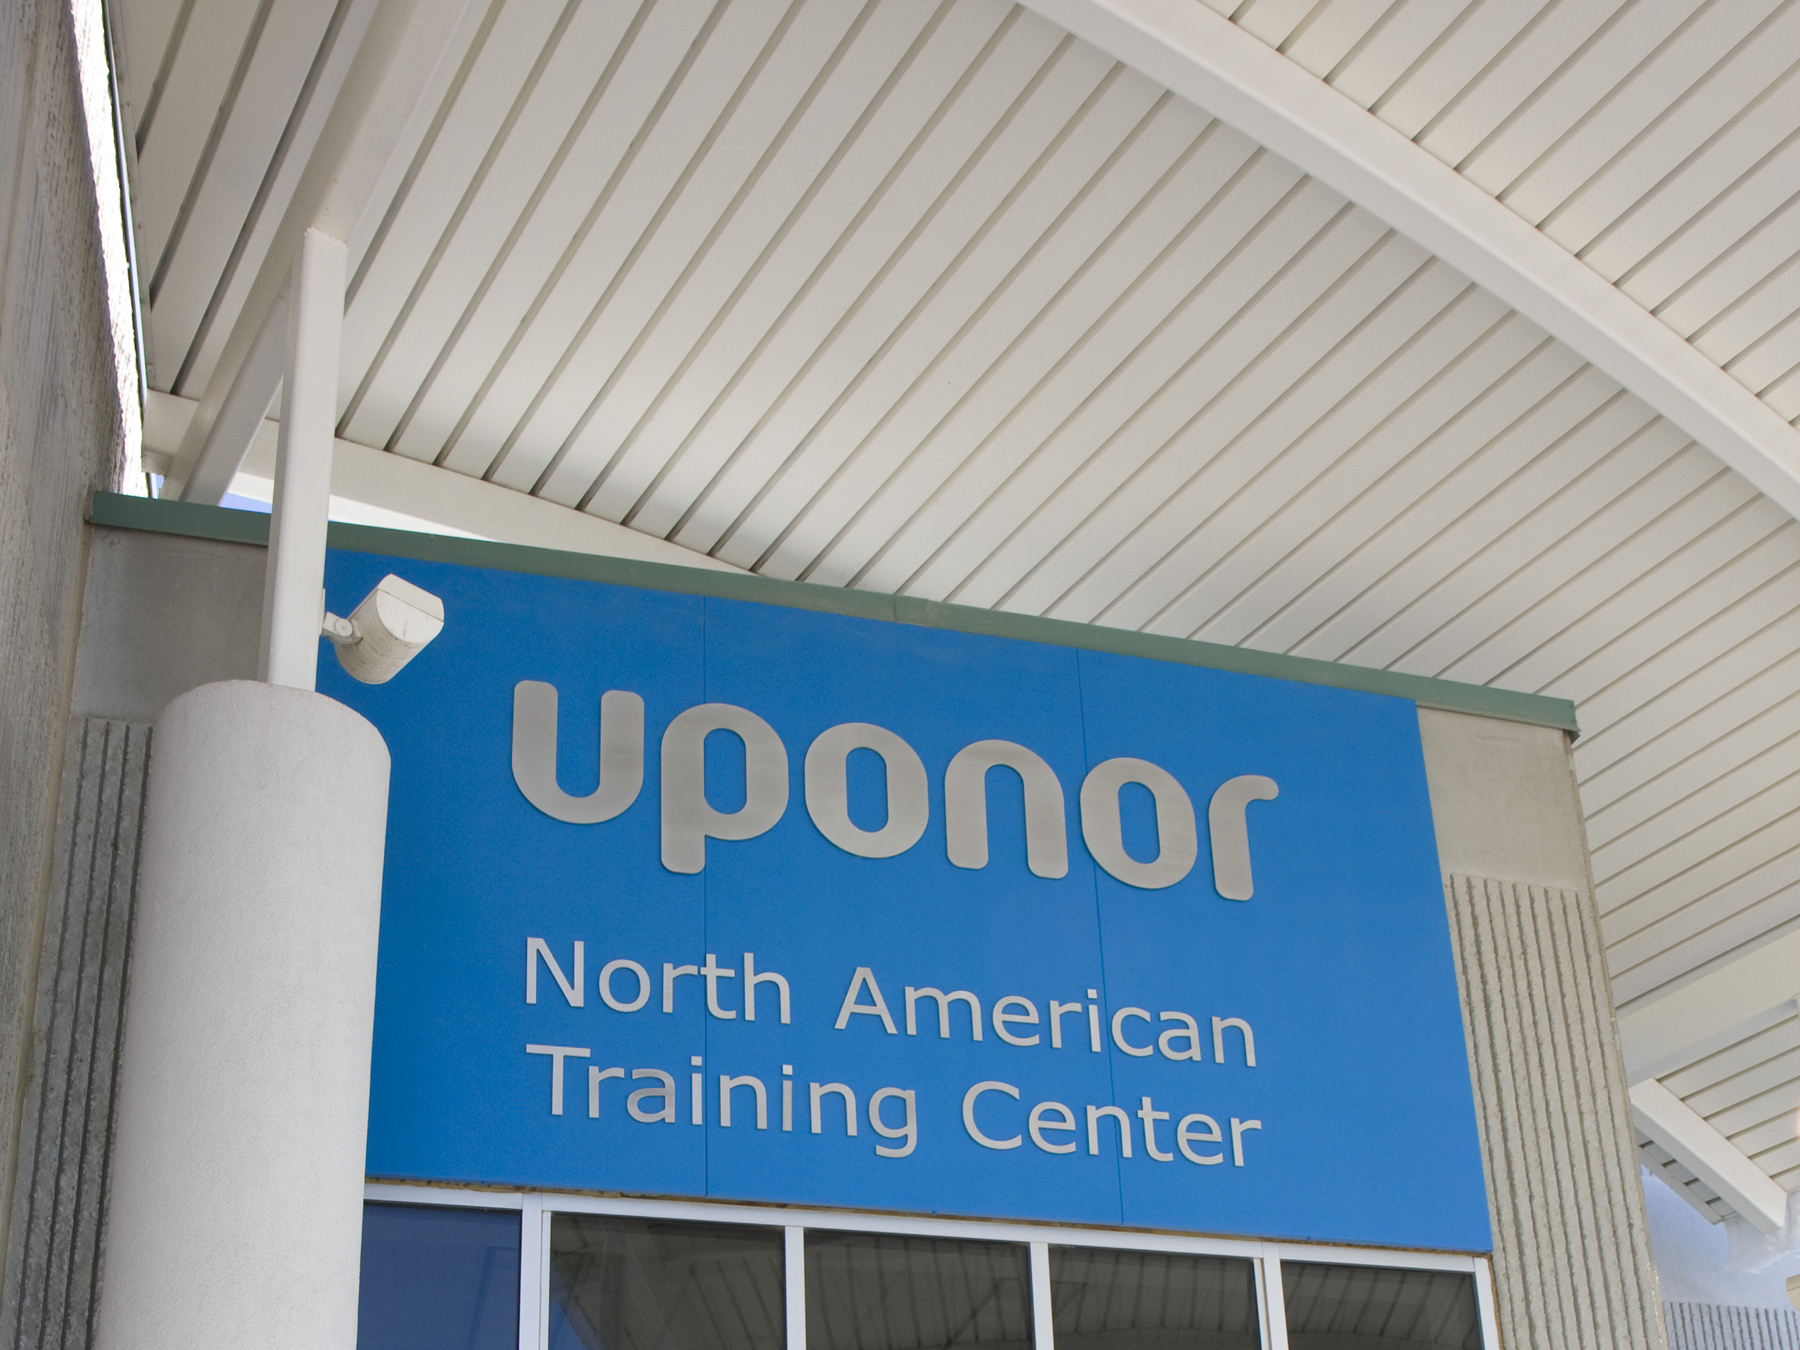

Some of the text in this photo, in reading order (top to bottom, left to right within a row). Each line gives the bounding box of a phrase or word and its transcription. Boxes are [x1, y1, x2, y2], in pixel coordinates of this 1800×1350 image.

[511, 680, 1279, 902] uponor
[526, 937, 1257, 1067] North American
[526, 1044, 1262, 1167] Training Center
